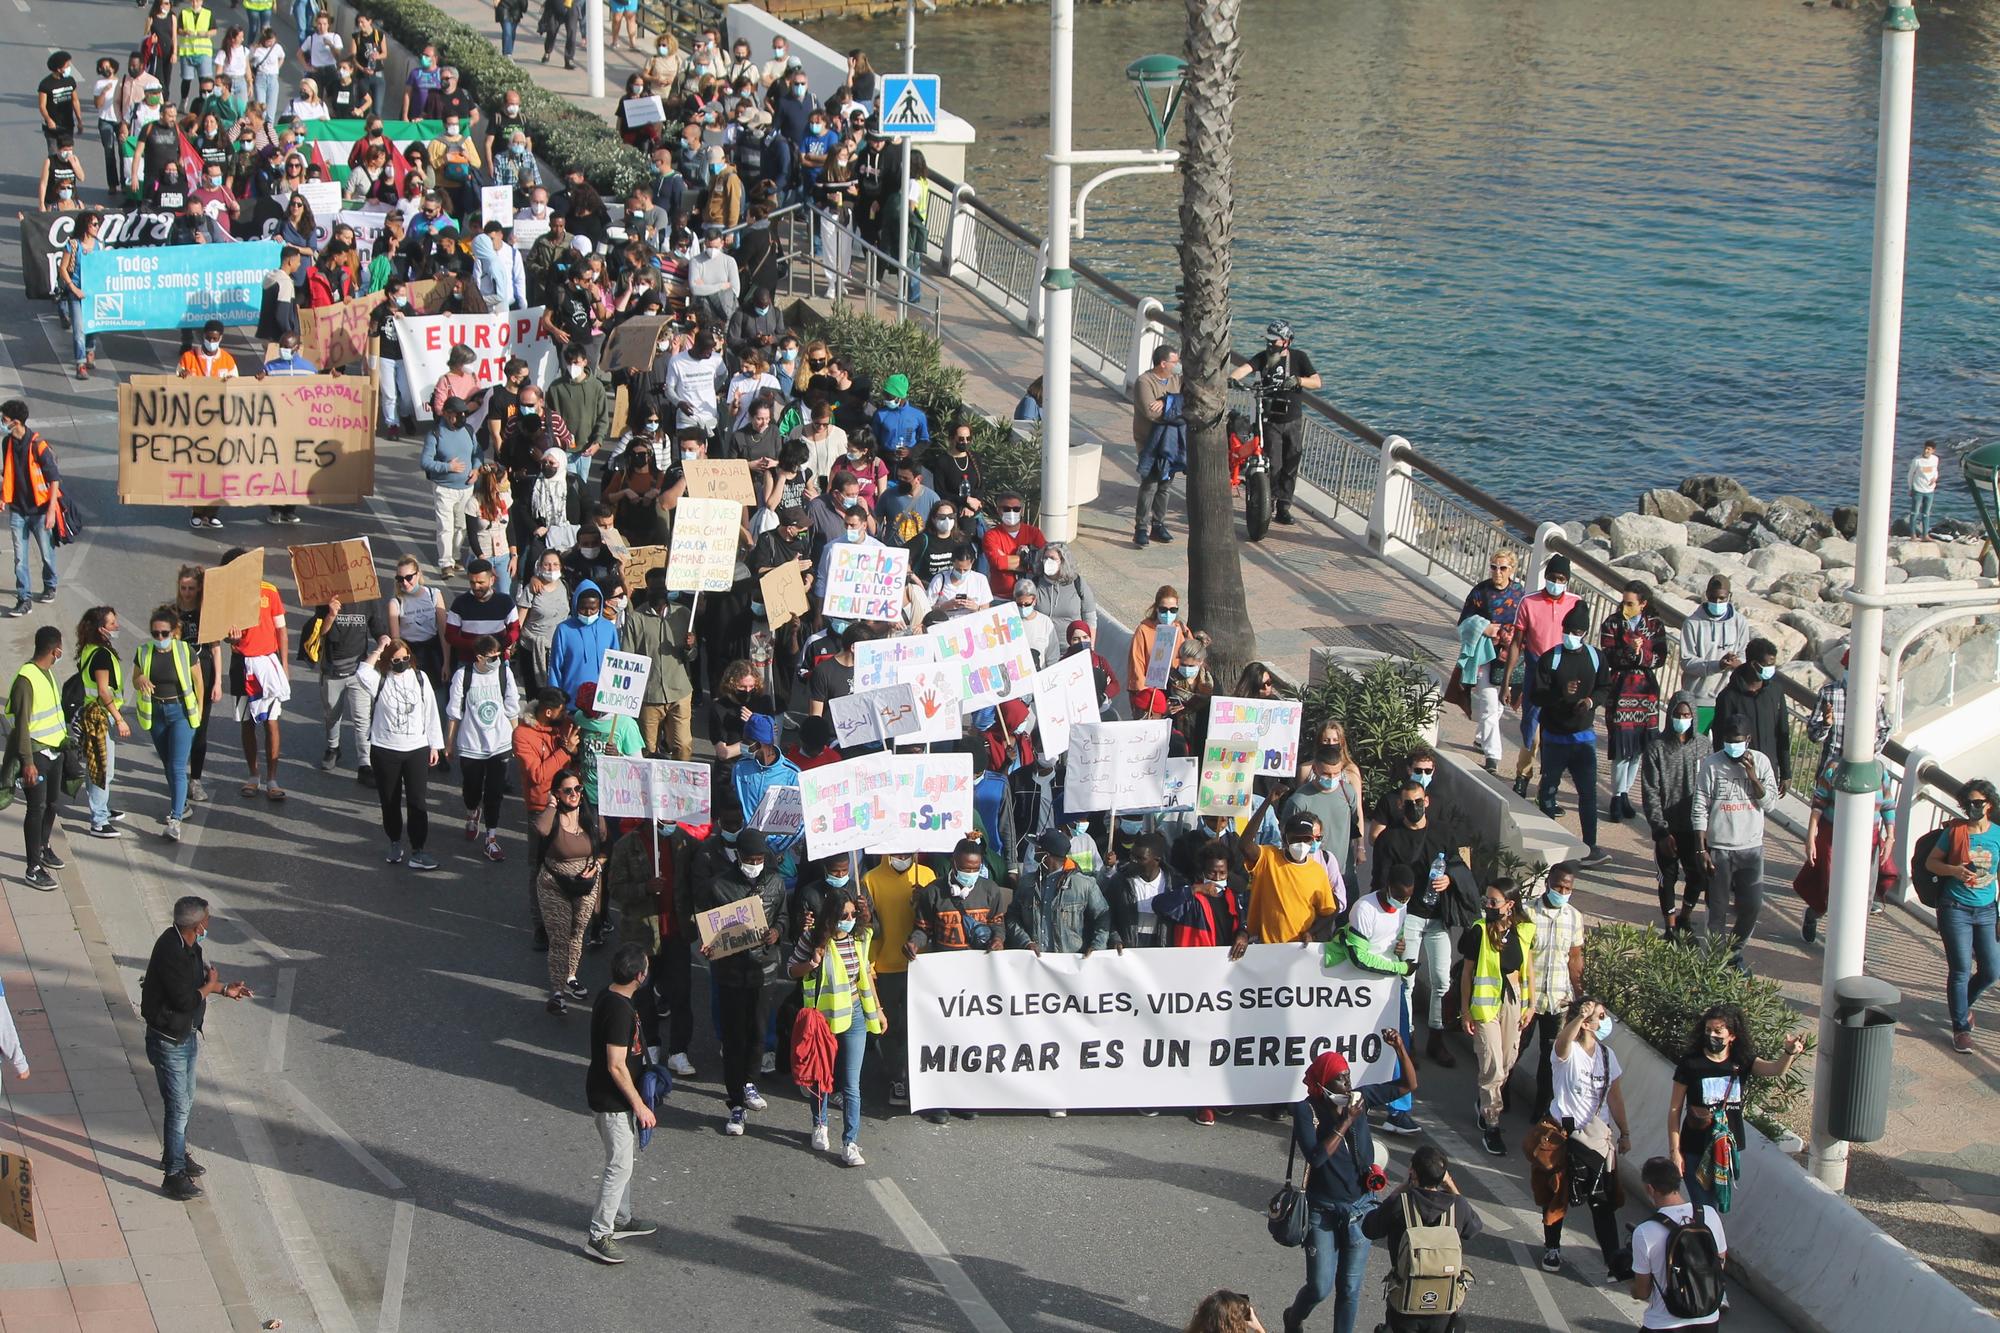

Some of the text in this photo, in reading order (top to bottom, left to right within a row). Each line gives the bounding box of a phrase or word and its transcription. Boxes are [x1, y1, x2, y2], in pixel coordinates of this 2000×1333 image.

[48, 209, 175, 248] cntra
[158, 272, 199, 289] somos
[205, 272, 212, 291] y
[186, 288, 250, 309] migrantes
[426, 317, 549, 350] EUROPA
[311, 403, 333, 414] NO
[132, 434, 336, 468] PERSONA ES
[168, 469, 314, 499] ILEGAL
[708, 480, 728, 492] NO
[837, 549, 904, 576] Derechos
[704, 579, 730, 590] ROGER
[834, 569, 903, 590] HUMANOS
[855, 583, 893, 596] EN LAS
[606, 656, 646, 674] TARAJAL
[612, 674, 631, 690] NO
[597, 690, 640, 710] OLVIDAMOS
[1208, 747, 1256, 769] Migrar
[1204, 769, 1220, 781] es
[919, 804, 963, 831] Surs
[1720, 803, 1745, 811] ABOUT
[938, 986, 1372, 1018] VÍAS LEGALES, VIDAS SEGURAS
[920, 1033, 1383, 1074] MIGRAR ES UN DERECHO
